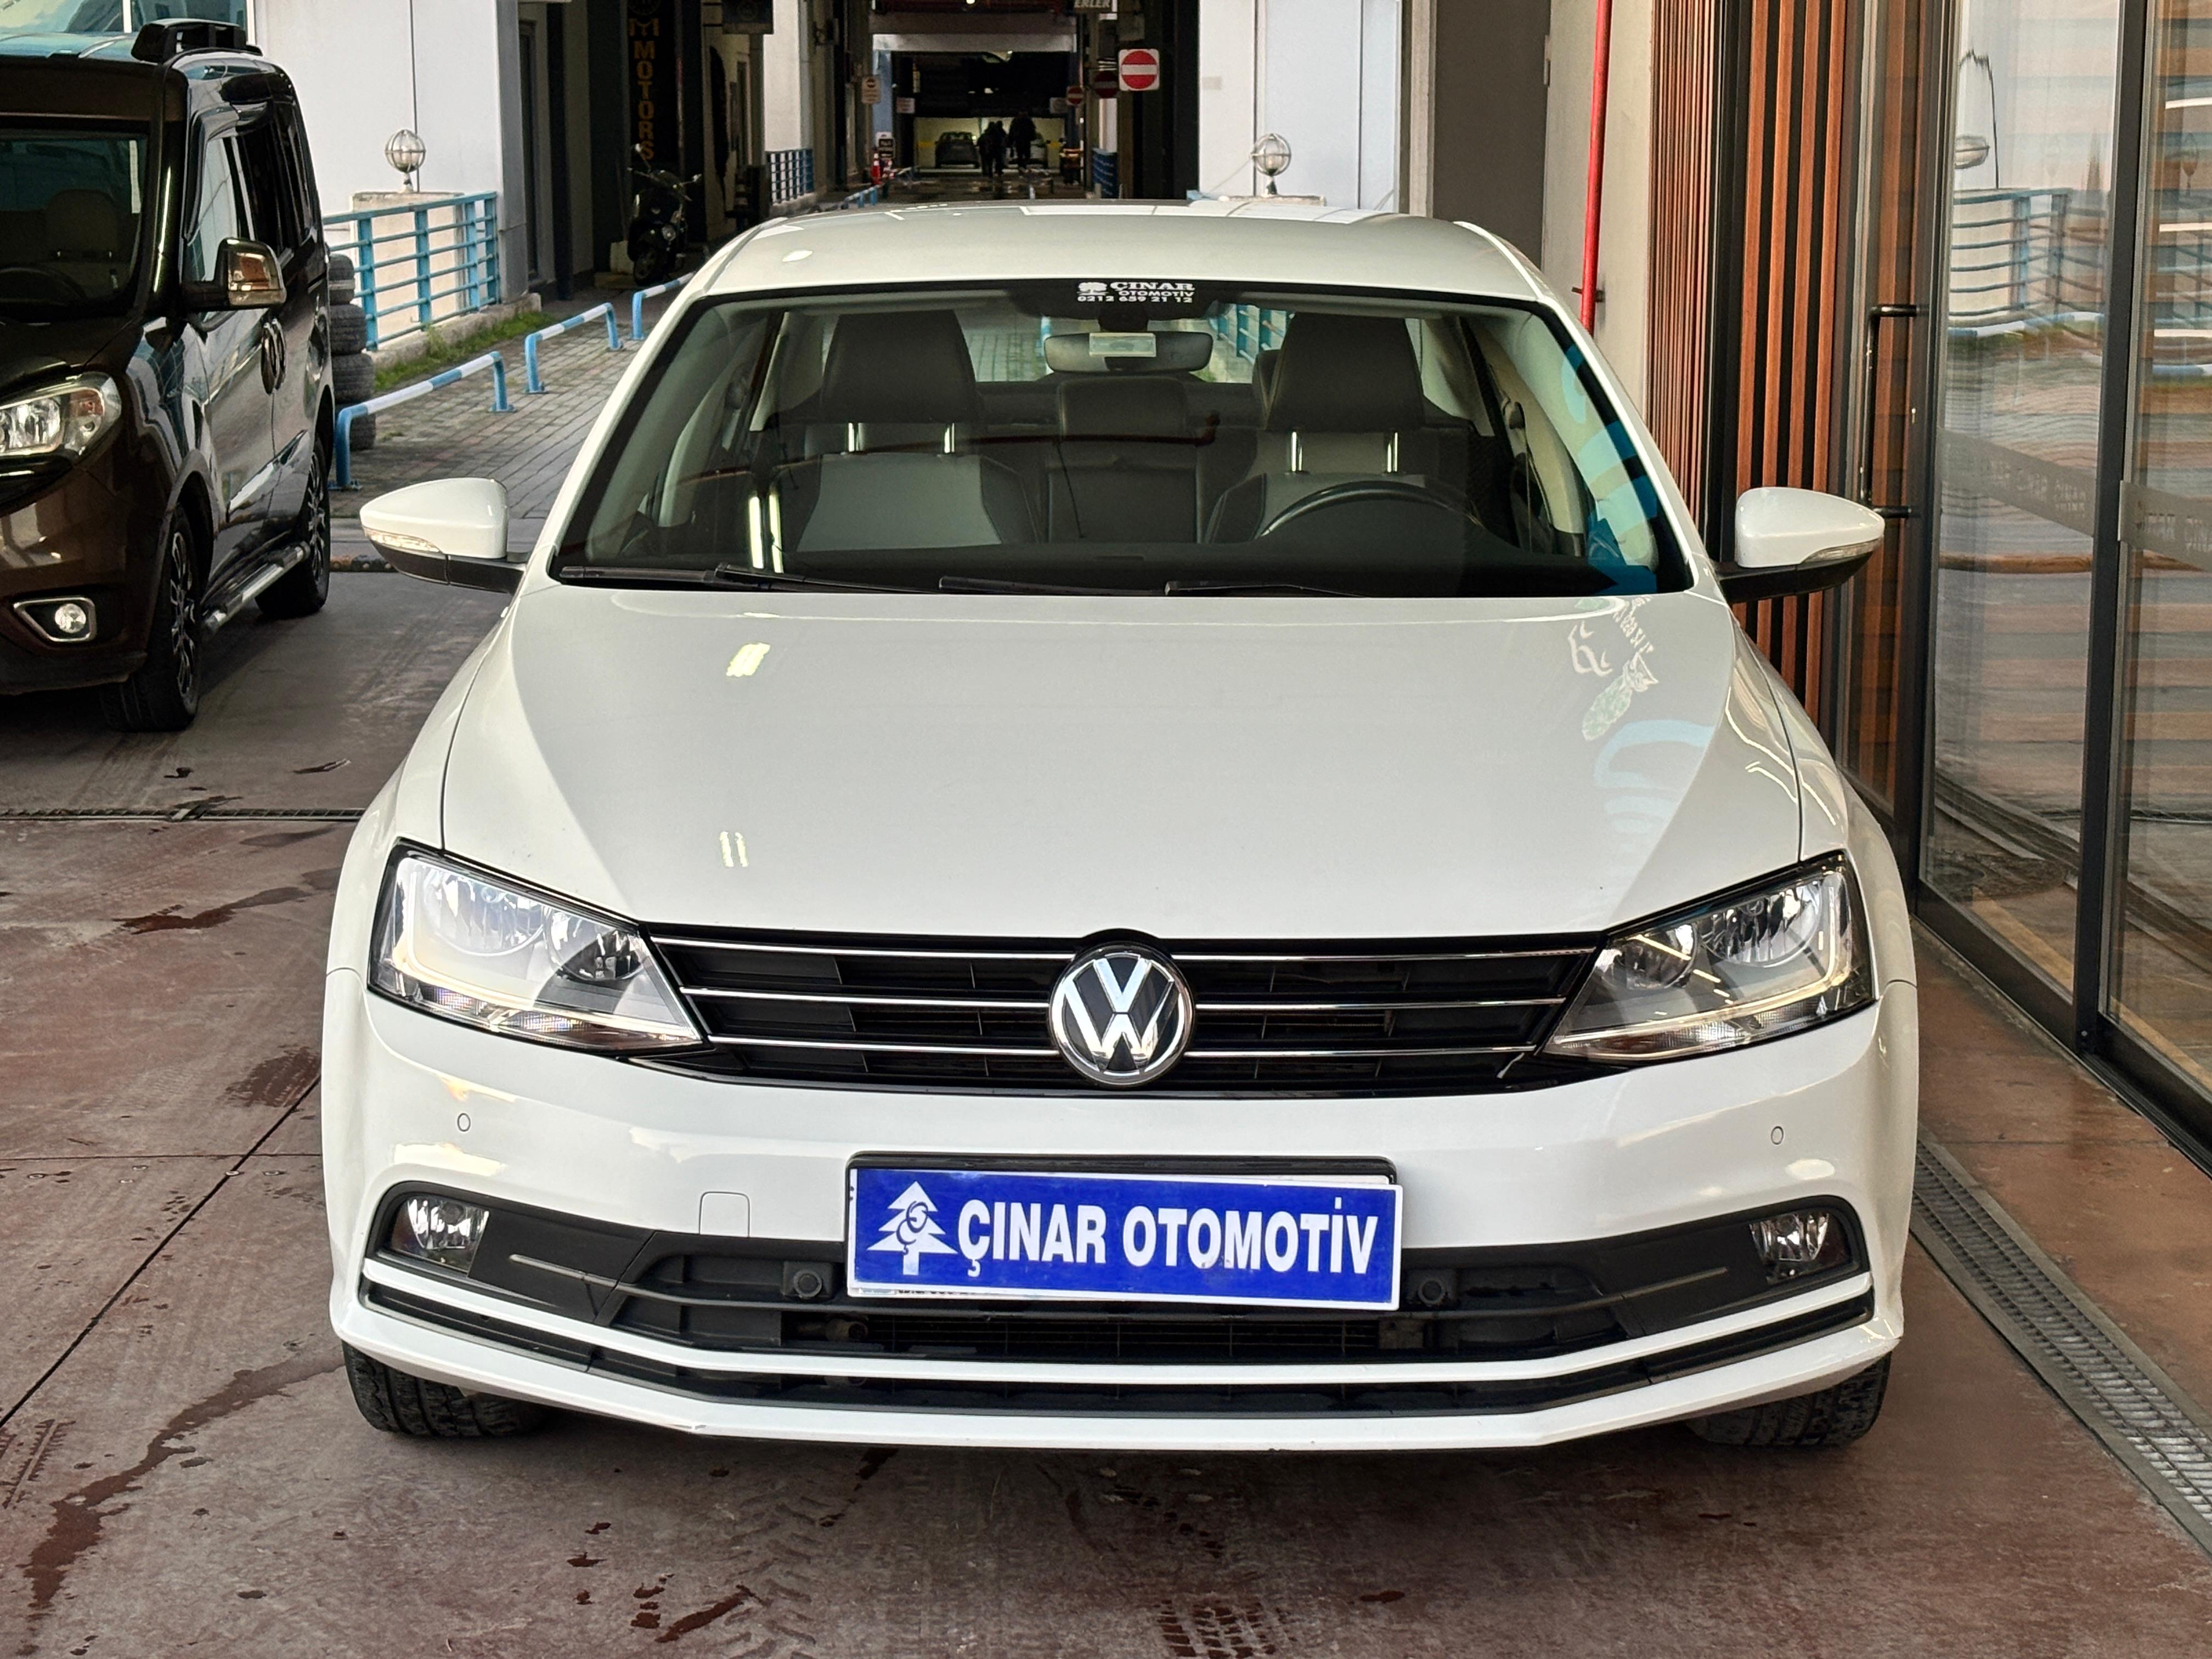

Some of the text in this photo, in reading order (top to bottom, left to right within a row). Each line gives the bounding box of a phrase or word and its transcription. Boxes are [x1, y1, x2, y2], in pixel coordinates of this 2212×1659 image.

[634, 40, 655, 160] MOTORS
[958, 1197, 1378, 1277] ÇINAR OTOMOTİV
